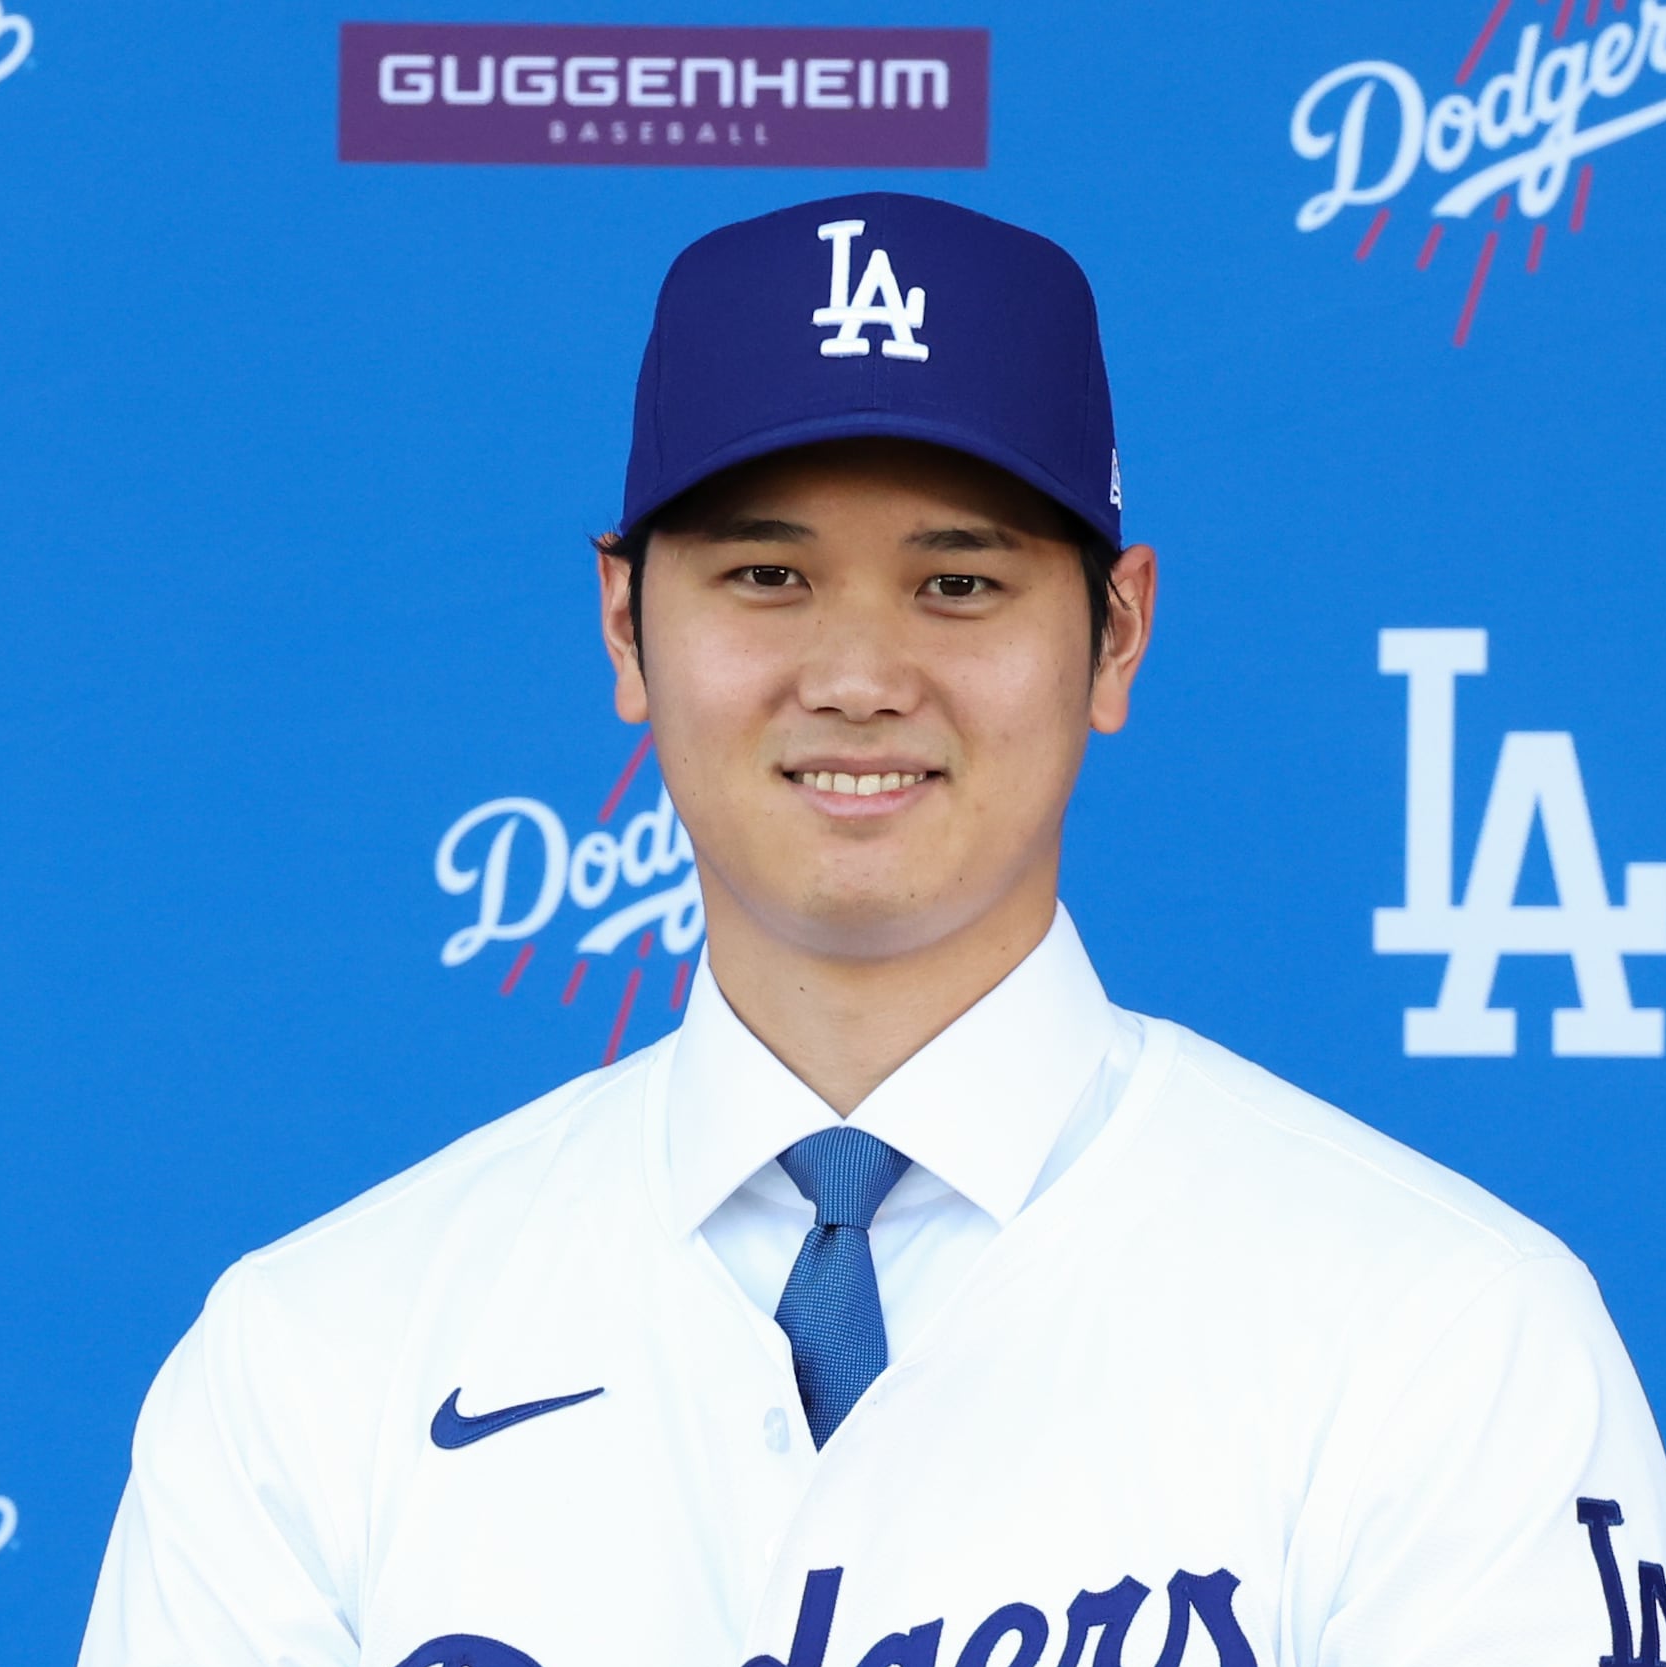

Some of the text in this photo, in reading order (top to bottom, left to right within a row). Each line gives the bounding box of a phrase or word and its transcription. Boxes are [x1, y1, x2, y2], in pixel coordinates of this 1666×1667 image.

[378, 54, 950, 109] GUGGENHEIM
[549, 120, 769, 145] BASEBALL
[812, 219, 930, 363] LA
